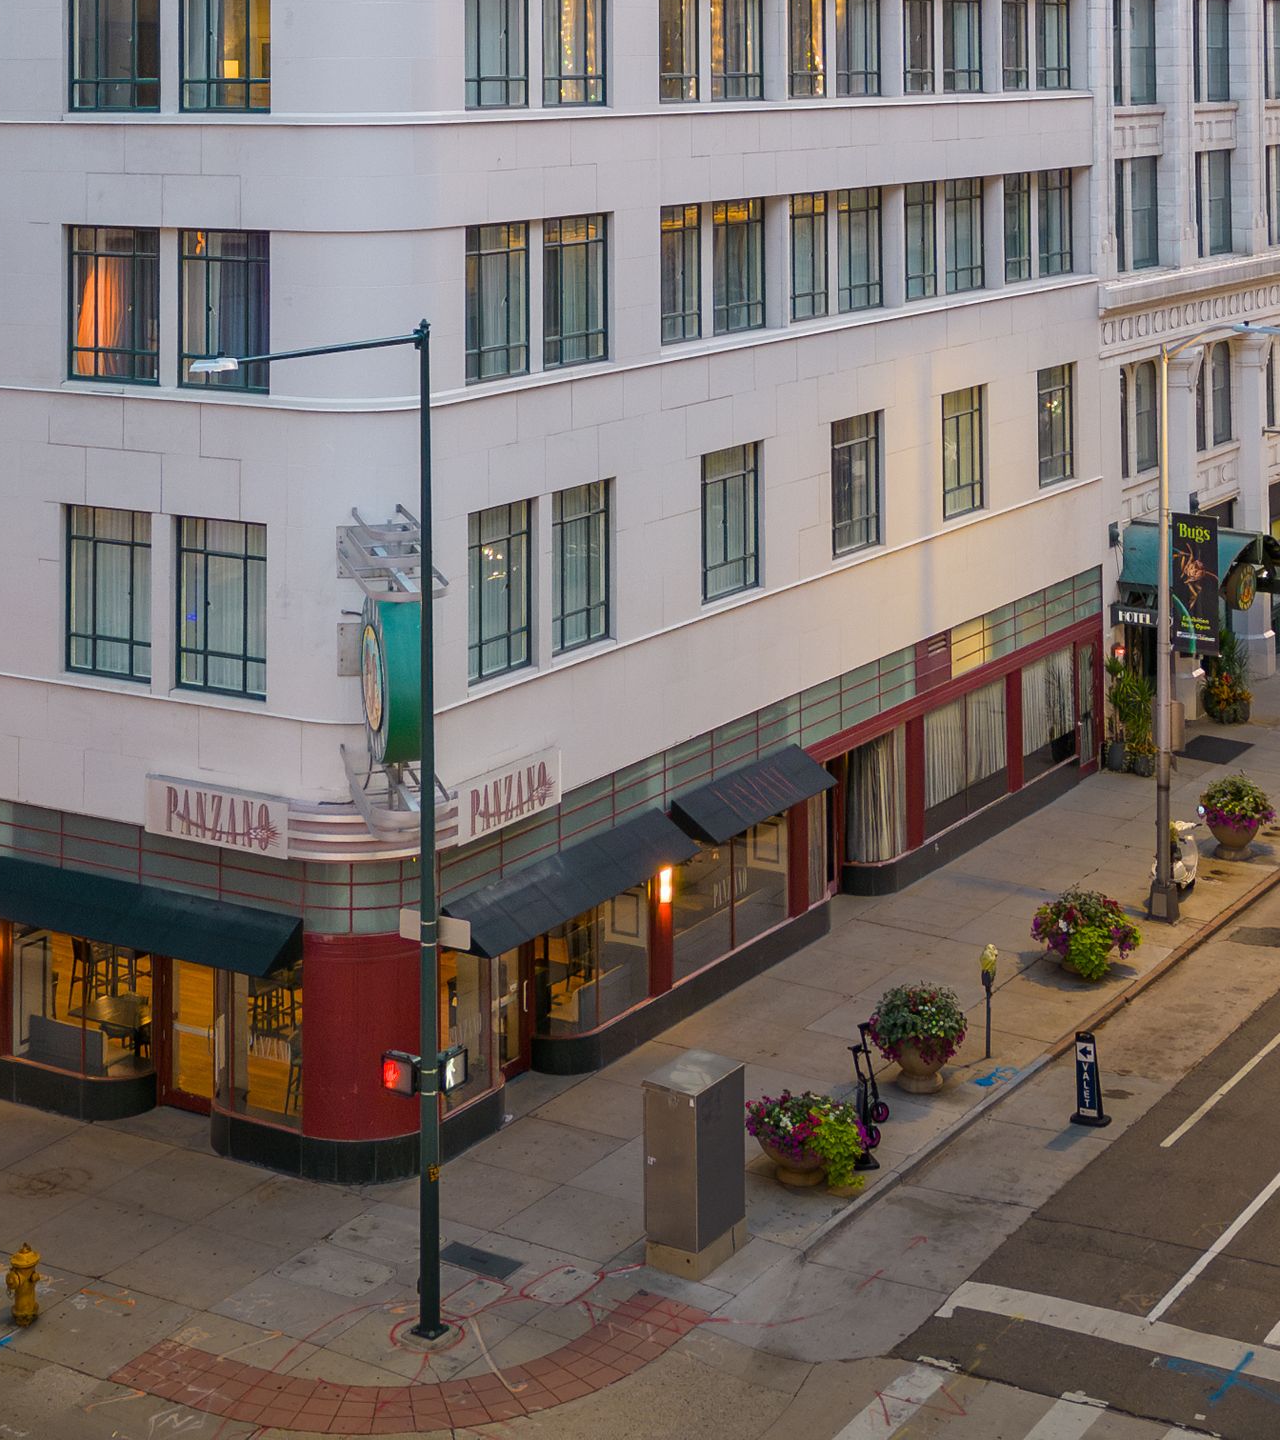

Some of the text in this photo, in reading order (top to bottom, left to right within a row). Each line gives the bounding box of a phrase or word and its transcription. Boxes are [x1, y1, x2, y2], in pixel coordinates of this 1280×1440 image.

[1178, 523, 1211, 544] Bugs
[1118, 610, 1153, 625] HOTEL
[166, 786, 272, 851] PANZANO
[469, 761, 548, 836] PANZANO
[1082, 1062, 1090, 1108] VALET
